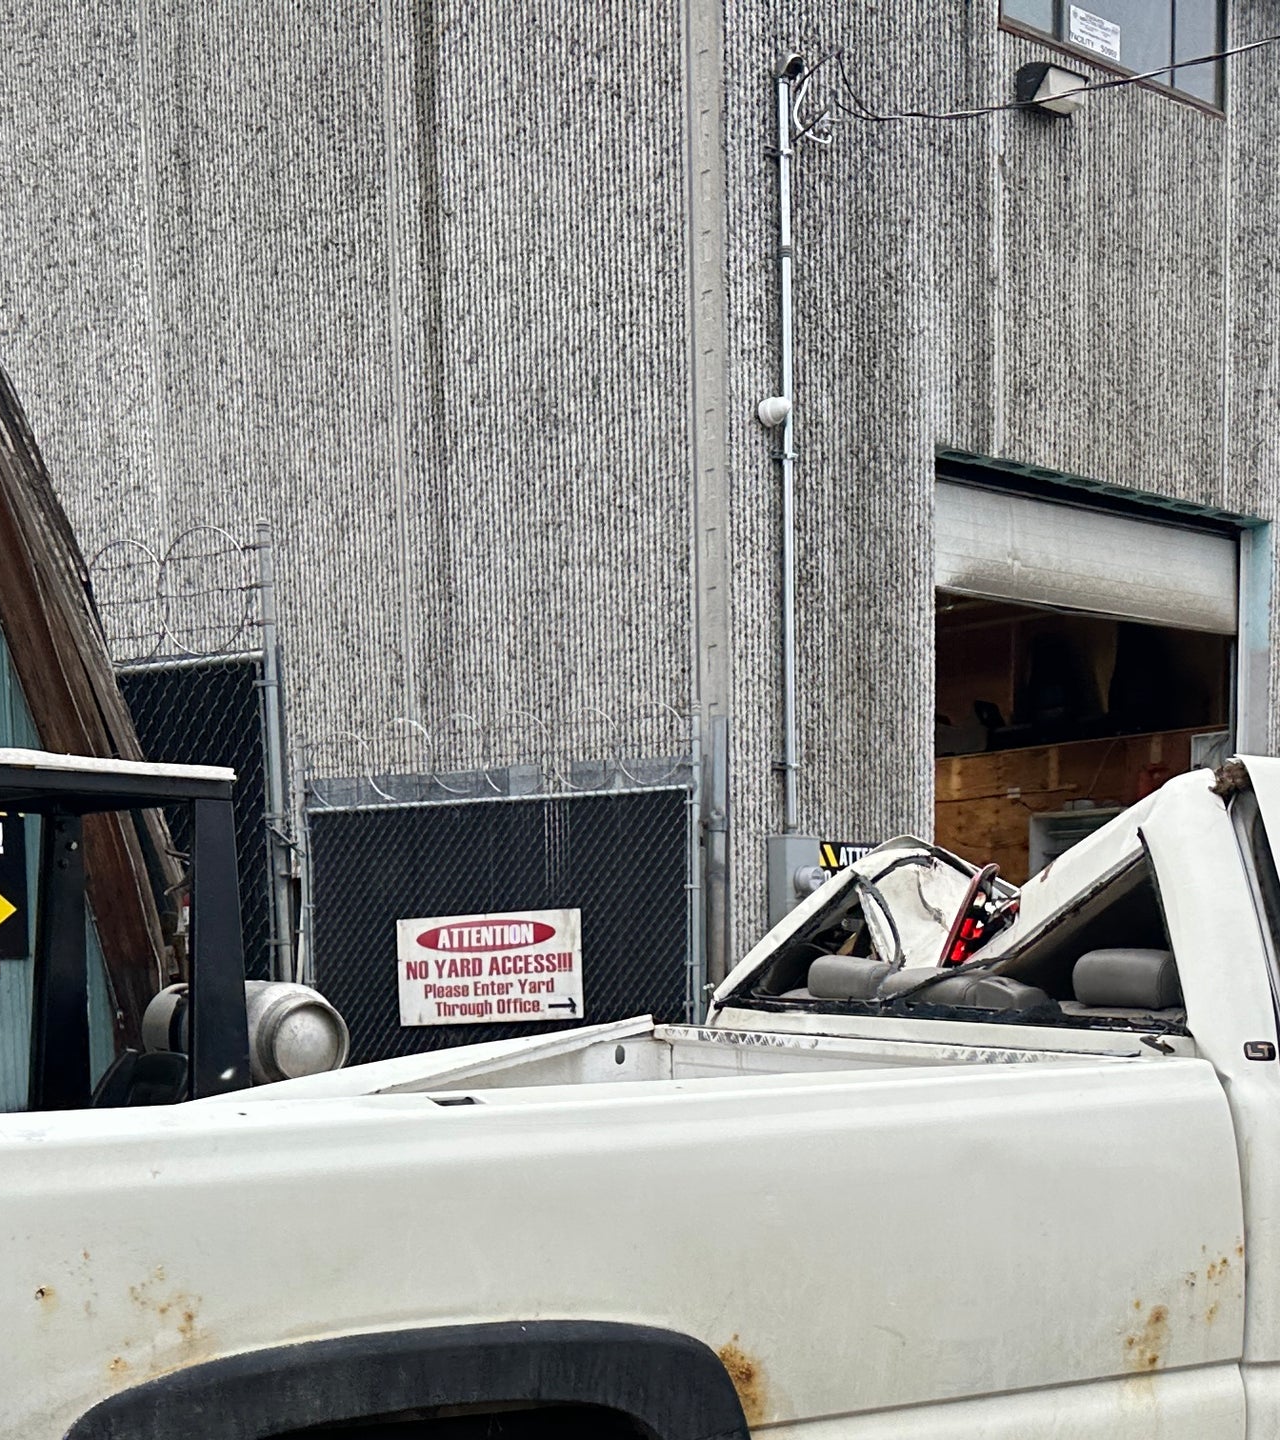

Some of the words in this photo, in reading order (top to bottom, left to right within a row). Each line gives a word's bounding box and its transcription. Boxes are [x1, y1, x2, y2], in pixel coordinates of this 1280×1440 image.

[437, 923, 535, 950] ATTENTION
[405, 960, 429, 981] NO
[434, 957, 483, 979] YARD
[488, 952, 573, 977] ACCESS!!!
[424, 983, 470, 1000] Please
[473, 981, 514, 997] Enter
[518, 978, 555, 995] Yard
[435, 1000, 493, 1018] Through
[1246, 1043, 1274, 1057] LT
